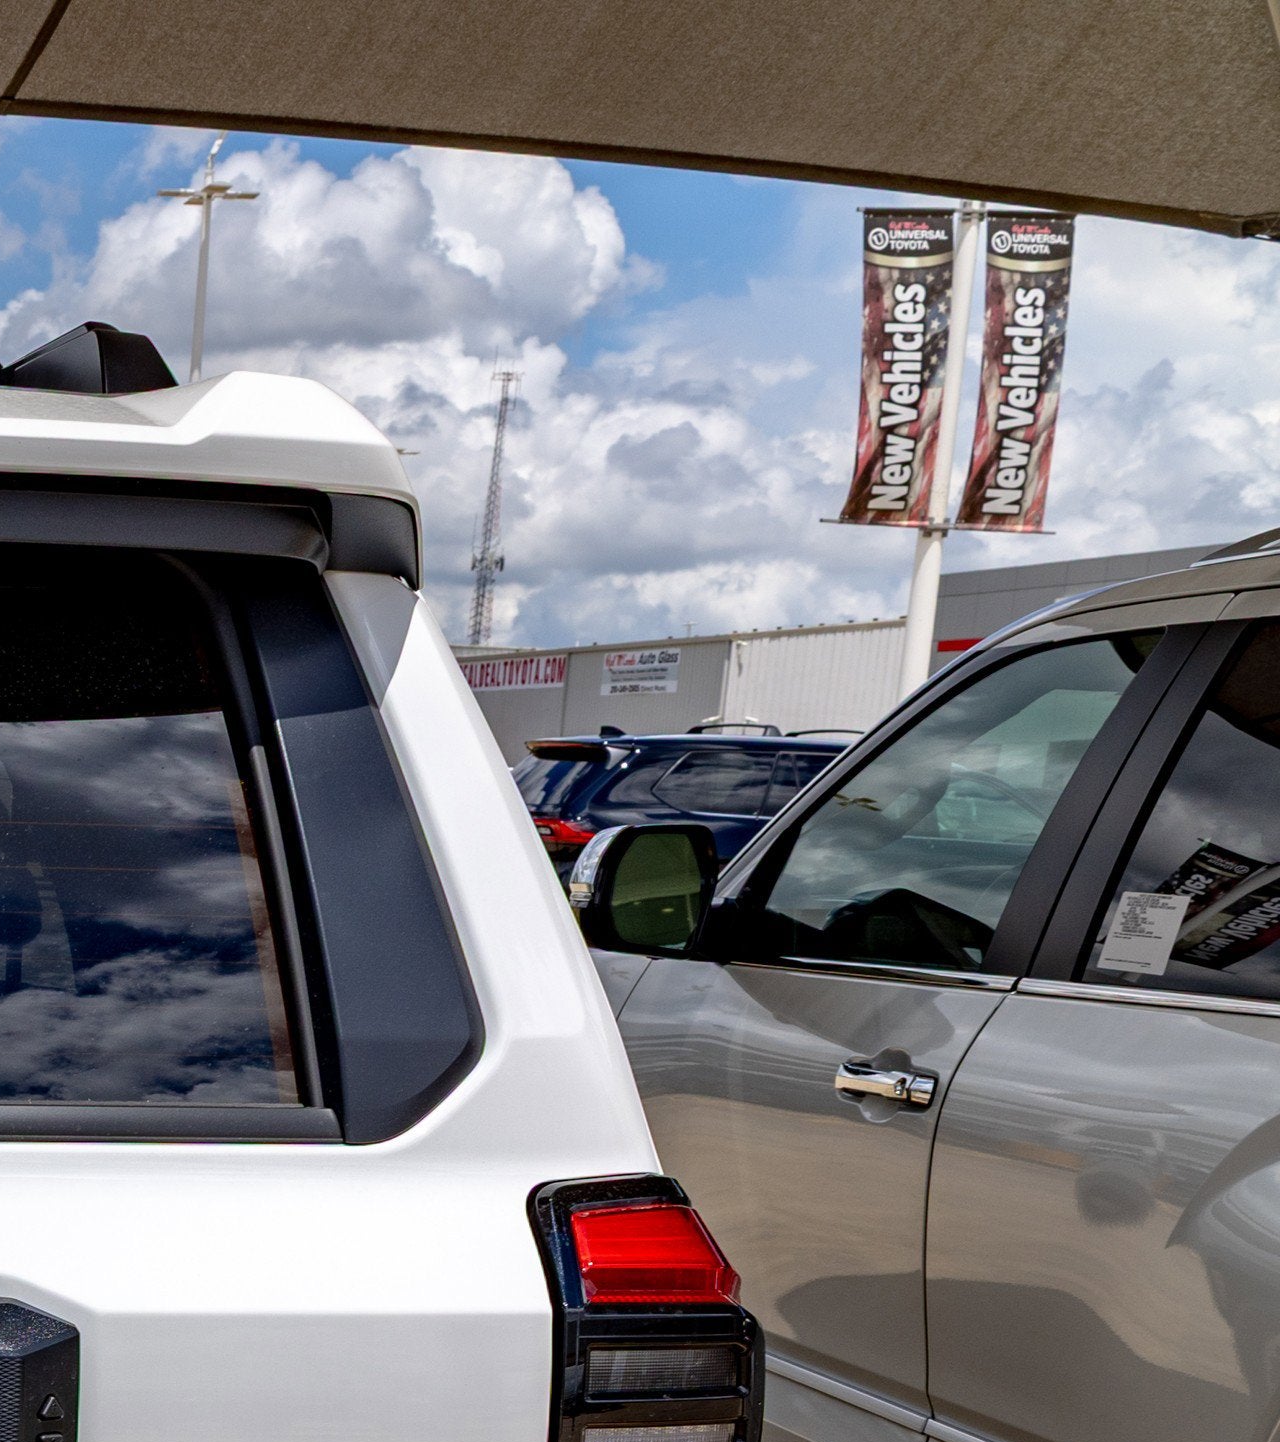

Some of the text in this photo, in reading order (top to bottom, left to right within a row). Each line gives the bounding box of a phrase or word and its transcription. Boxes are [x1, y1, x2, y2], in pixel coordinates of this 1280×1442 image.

[888, 229, 949, 240] UNIVERSAL
[889, 240, 931, 250] TOYOTA
[1011, 233, 1070, 245] UNIVERSAL
[1012, 244, 1051, 255] TOYOTA
[879, 283, 927, 428] Vehicles
[996, 287, 1046, 431] Vehicles
[866, 433, 916, 511] New
[981, 437, 1032, 515] New
[459, 657, 567, 688] EALDEALTOYOTA.COM
